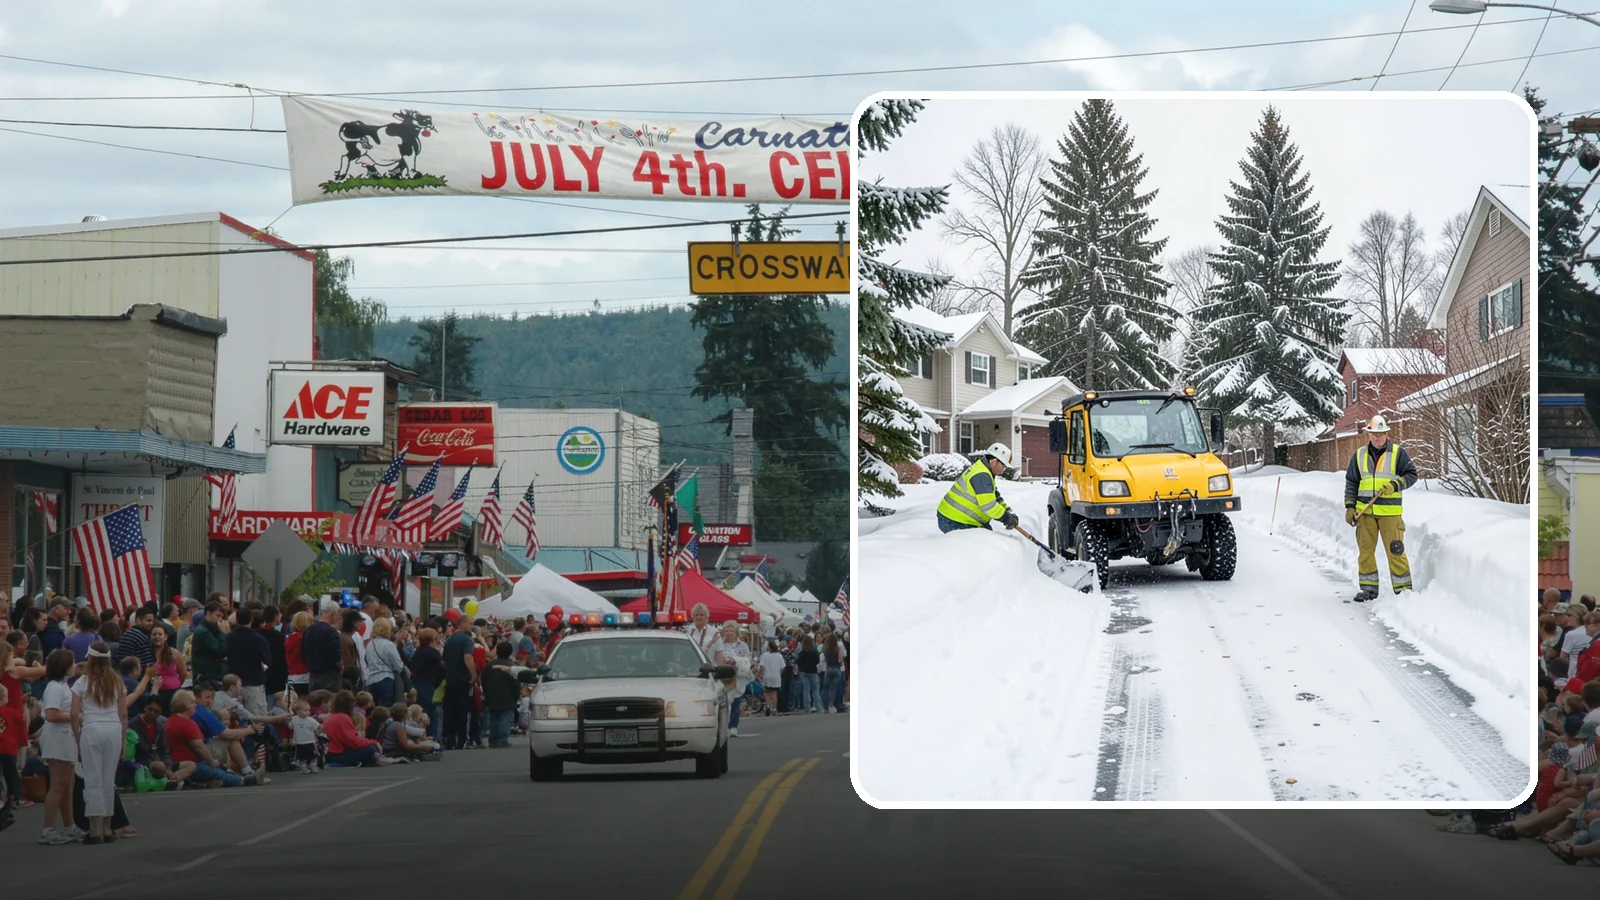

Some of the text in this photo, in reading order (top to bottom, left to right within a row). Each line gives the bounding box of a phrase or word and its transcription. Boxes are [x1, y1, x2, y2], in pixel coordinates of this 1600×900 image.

[480, 140, 605, 192] JULY
[632, 149, 746, 198] 4th.
[697, 254, 850, 280] CROSSWA
[282, 379, 374, 420] ACE
[406, 409, 485, 421] CEDAR LOG
[283, 421, 371, 436] Hardware
[416, 428, 477, 447] Coca-Cola
[83, 484, 155, 495] St. Vincent de Paul
[81, 503, 154, 522] THT
[212, 516, 331, 535] HARDARE
[688, 526, 741, 535] CRNATION
[699, 535, 730, 543] GLASS
